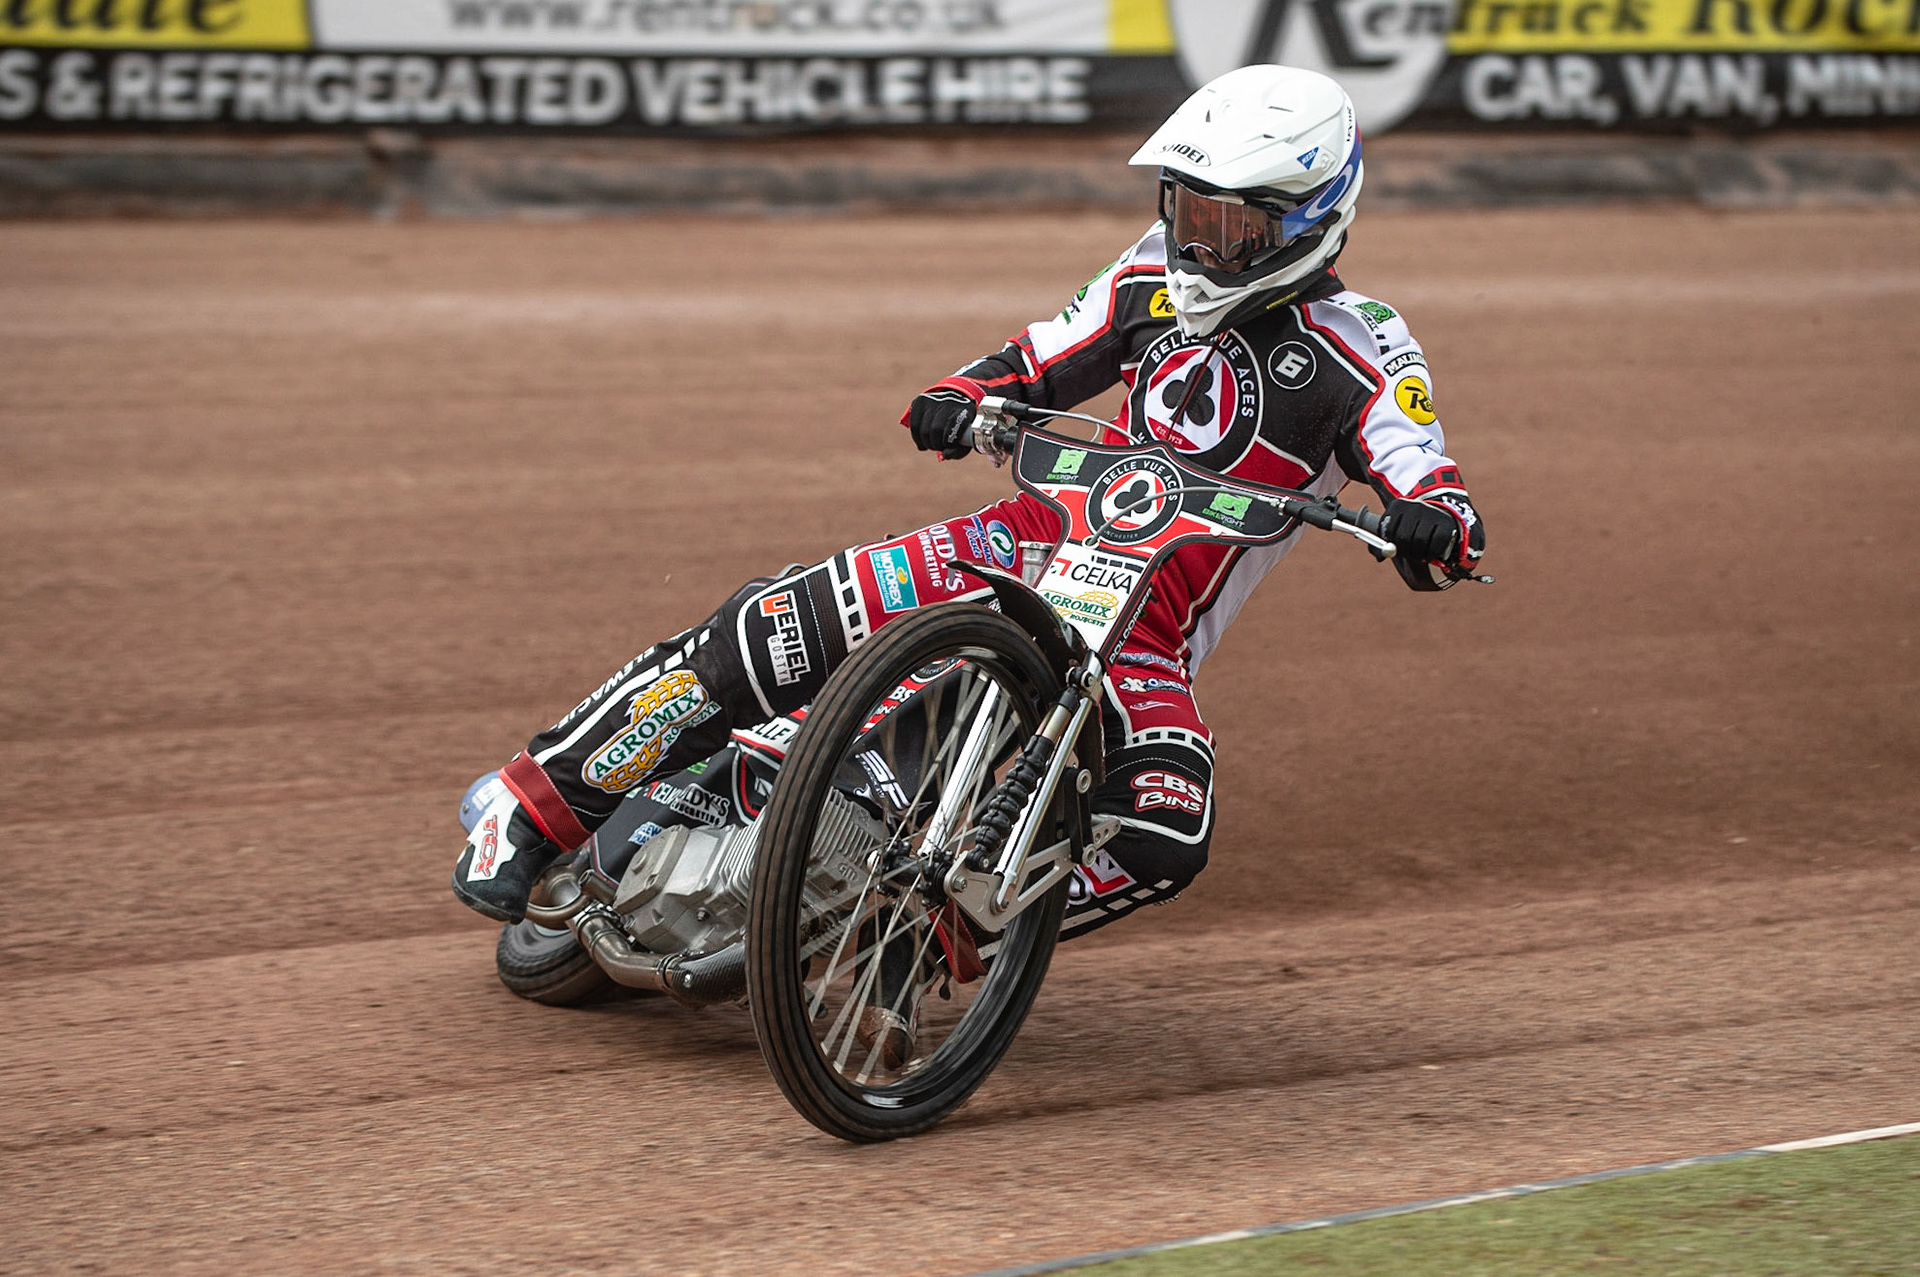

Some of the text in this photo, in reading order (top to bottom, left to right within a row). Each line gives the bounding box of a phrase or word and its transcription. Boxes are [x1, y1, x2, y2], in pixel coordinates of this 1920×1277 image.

[108, 52, 625, 124] REFRIGERATED
[633, 57, 924, 124] VEHICLE
[932, 58, 1090, 124] HIRE
[1464, 54, 1618, 126] CAR,
[1620, 54, 1778, 126] VAN,
[1150, 332, 1200, 363] BELL
[1236, 367, 1255, 418] ACES
[1275, 350, 1309, 378] 6
[1102, 460, 1178, 502] BELLE VUE ACS
[880, 551, 904, 608] MOTOREX
[1070, 563, 1133, 595] CELKA
[1043, 591, 1112, 618] AGROMIX
[888, 685, 916, 703] BS
[594, 689, 700, 779] AGROMIX
[1133, 772, 1203, 802] CBS
[1137, 791, 1202, 813] BINS
[475, 814, 498, 878] TCX
